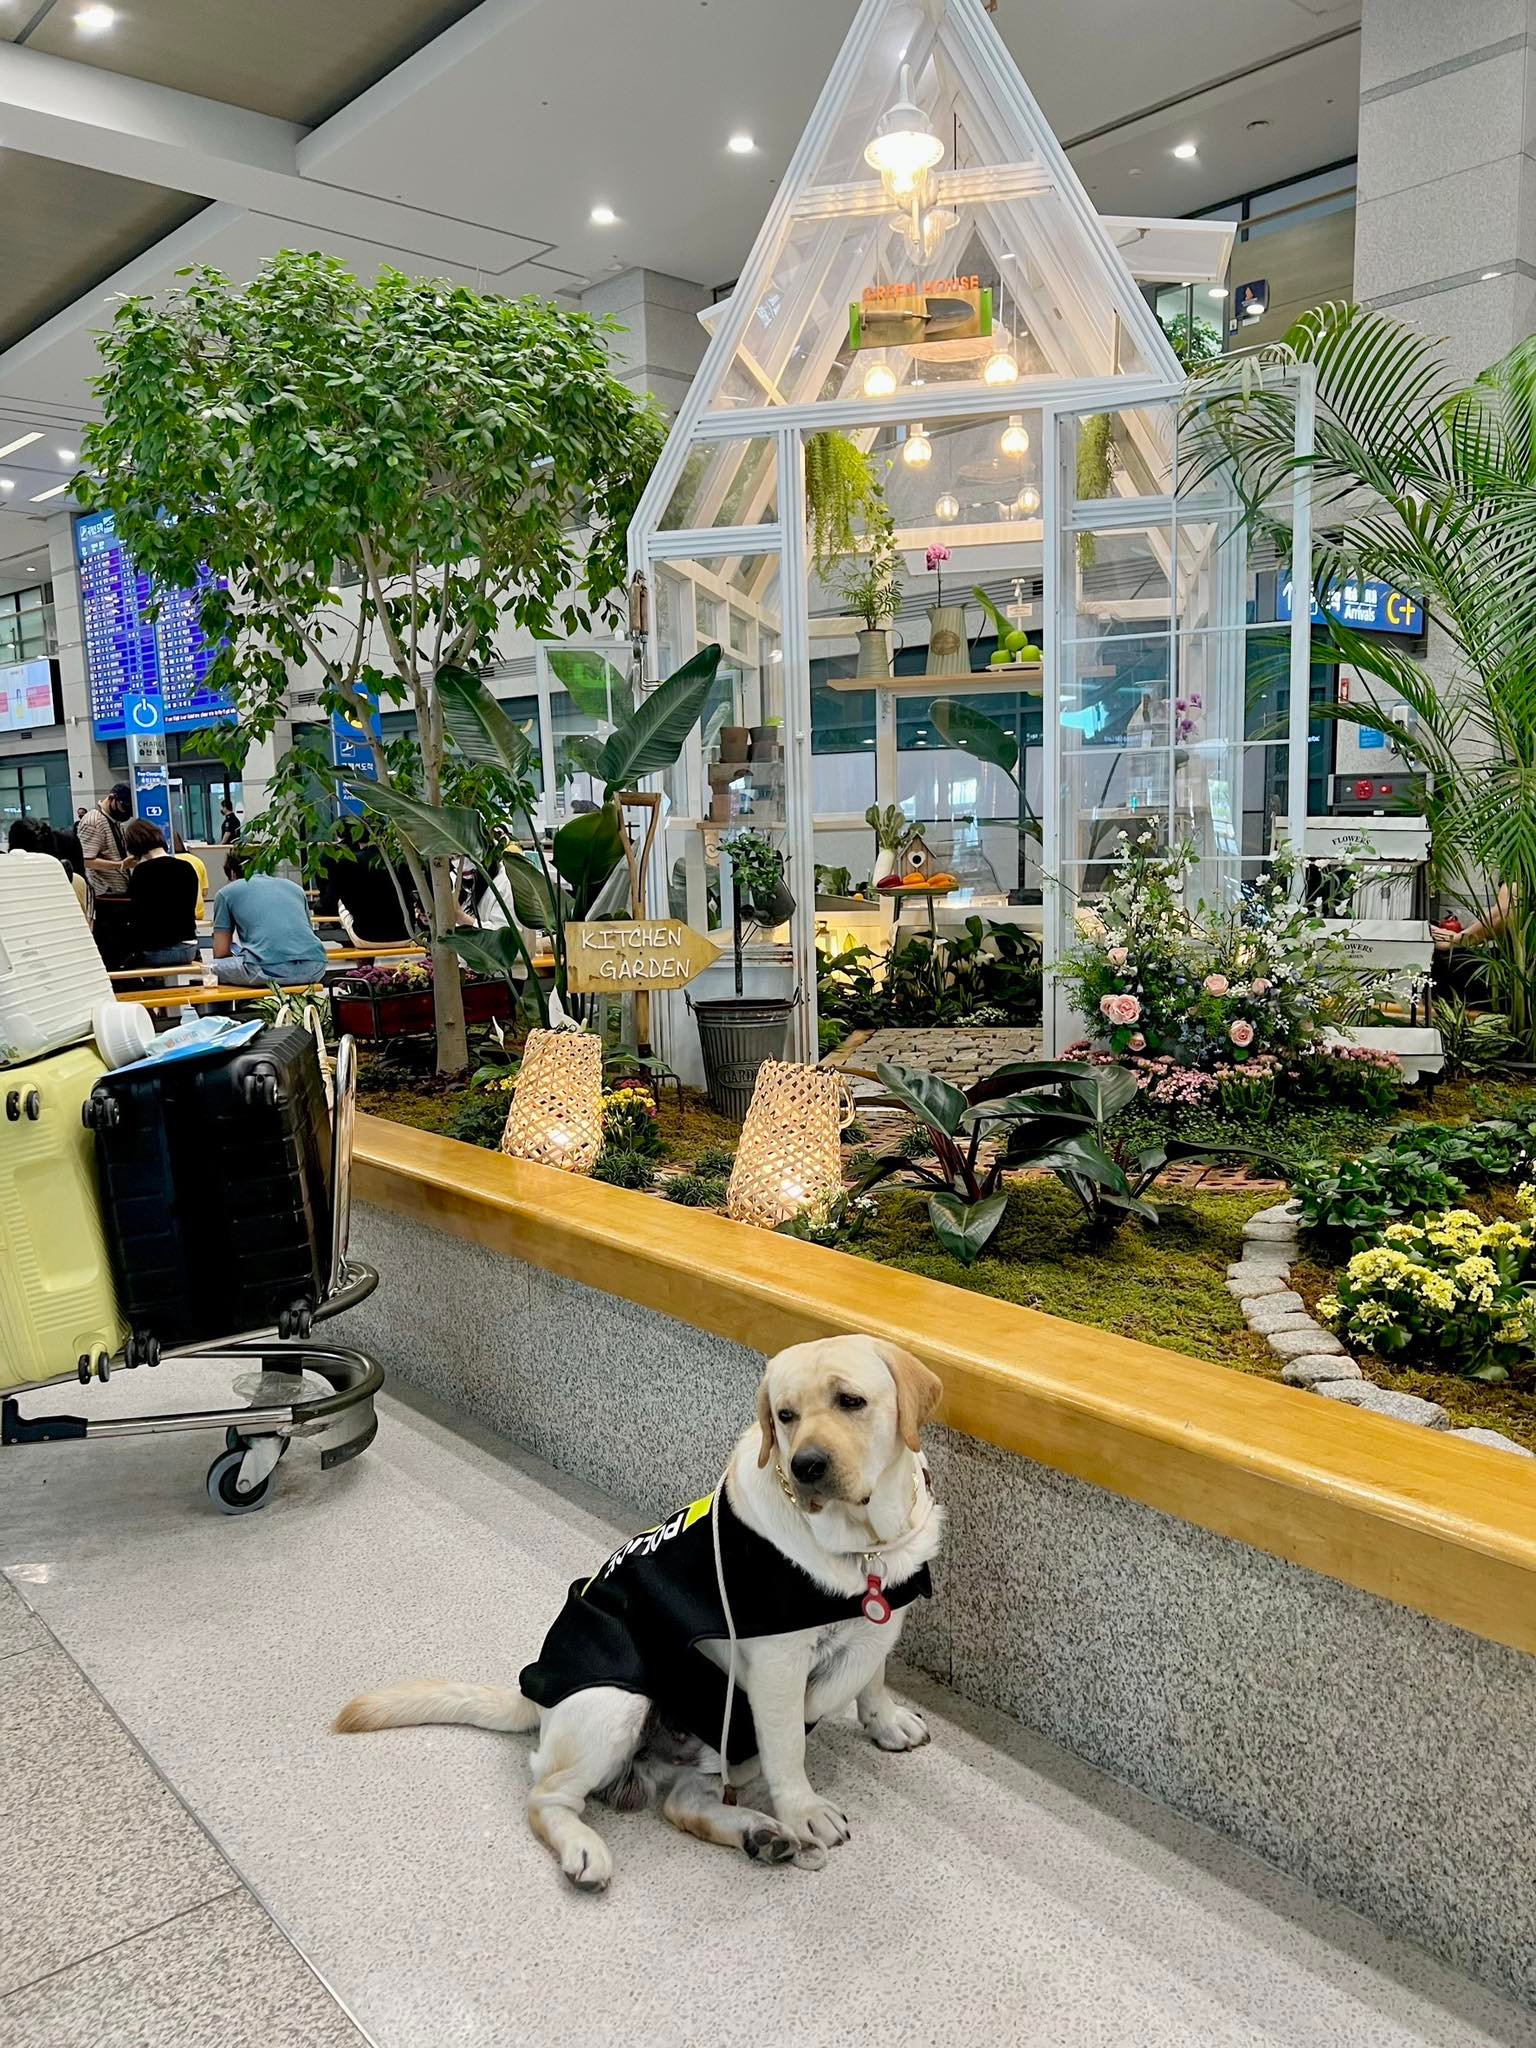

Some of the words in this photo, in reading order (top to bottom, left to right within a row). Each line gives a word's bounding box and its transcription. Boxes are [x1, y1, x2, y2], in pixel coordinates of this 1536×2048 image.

[1343, 604, 1377, 622] Arrivals
[1332, 835, 1371, 846] FLOWERS
[581, 927, 682, 950] KITCHEN
[1343, 943, 1374, 954] OWERS
[599, 957, 691, 981] GARDEN
[604, 1512, 685, 1580] POLICE
